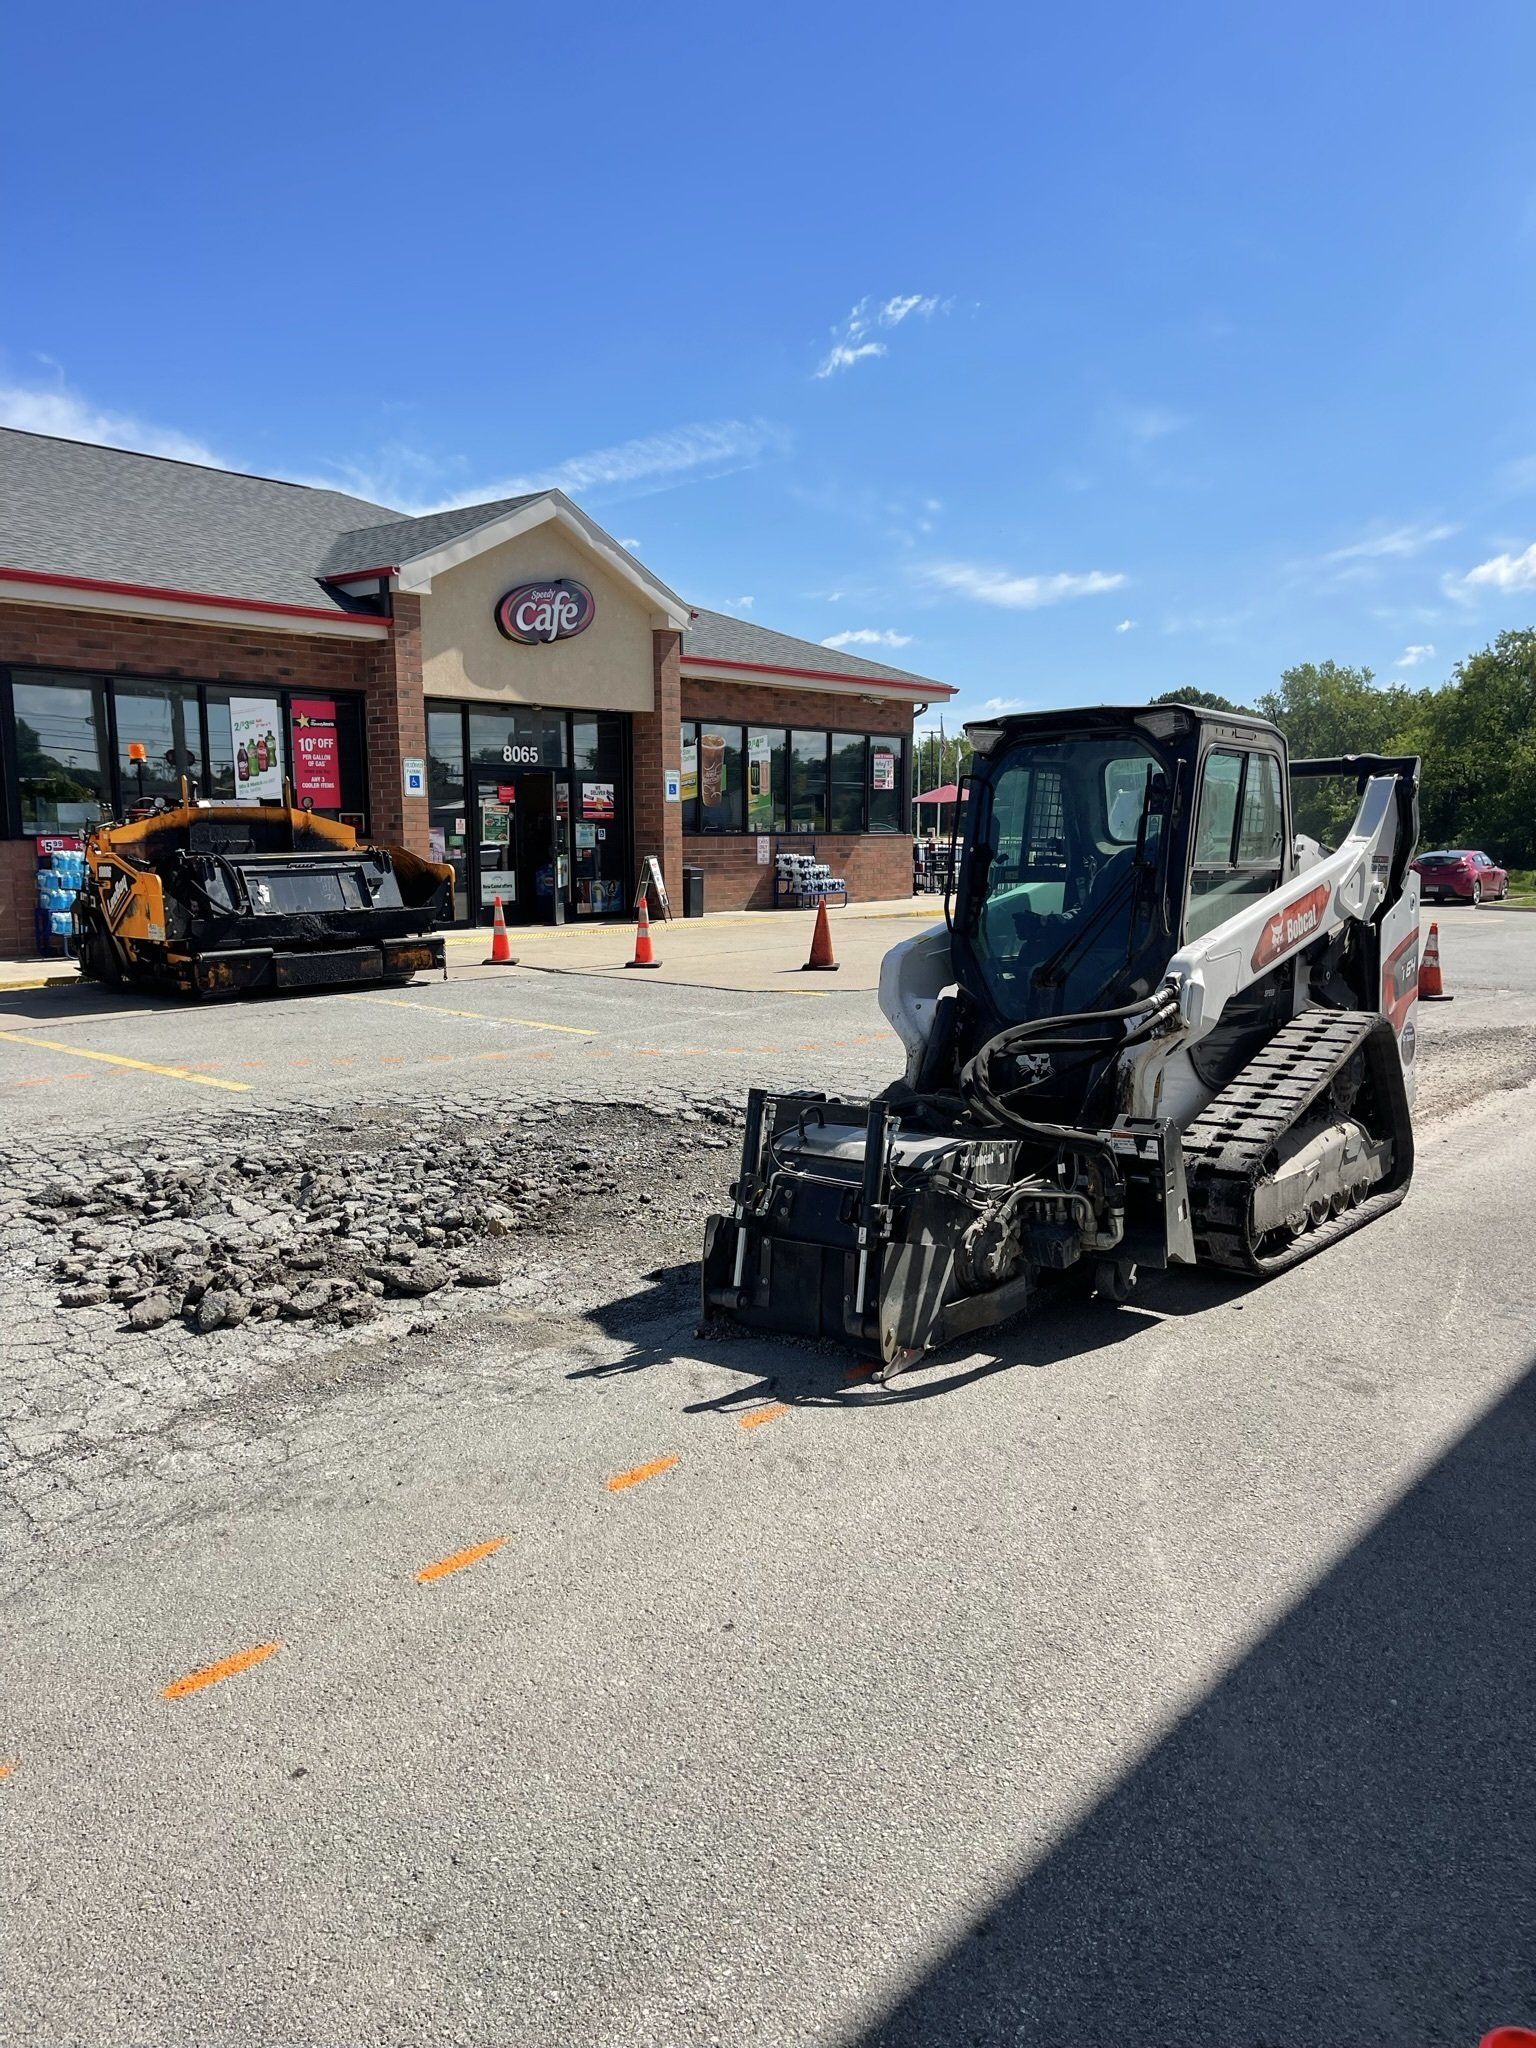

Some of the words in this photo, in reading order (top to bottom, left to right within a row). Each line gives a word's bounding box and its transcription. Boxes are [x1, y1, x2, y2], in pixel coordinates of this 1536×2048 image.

[531, 589, 556, 602] Speedy
[317, 738, 334, 748] OFF
[503, 745, 538, 763] 8065
[1287, 904, 1317, 943] Bobcat
[971, 1151, 993, 1168] Bobcat
